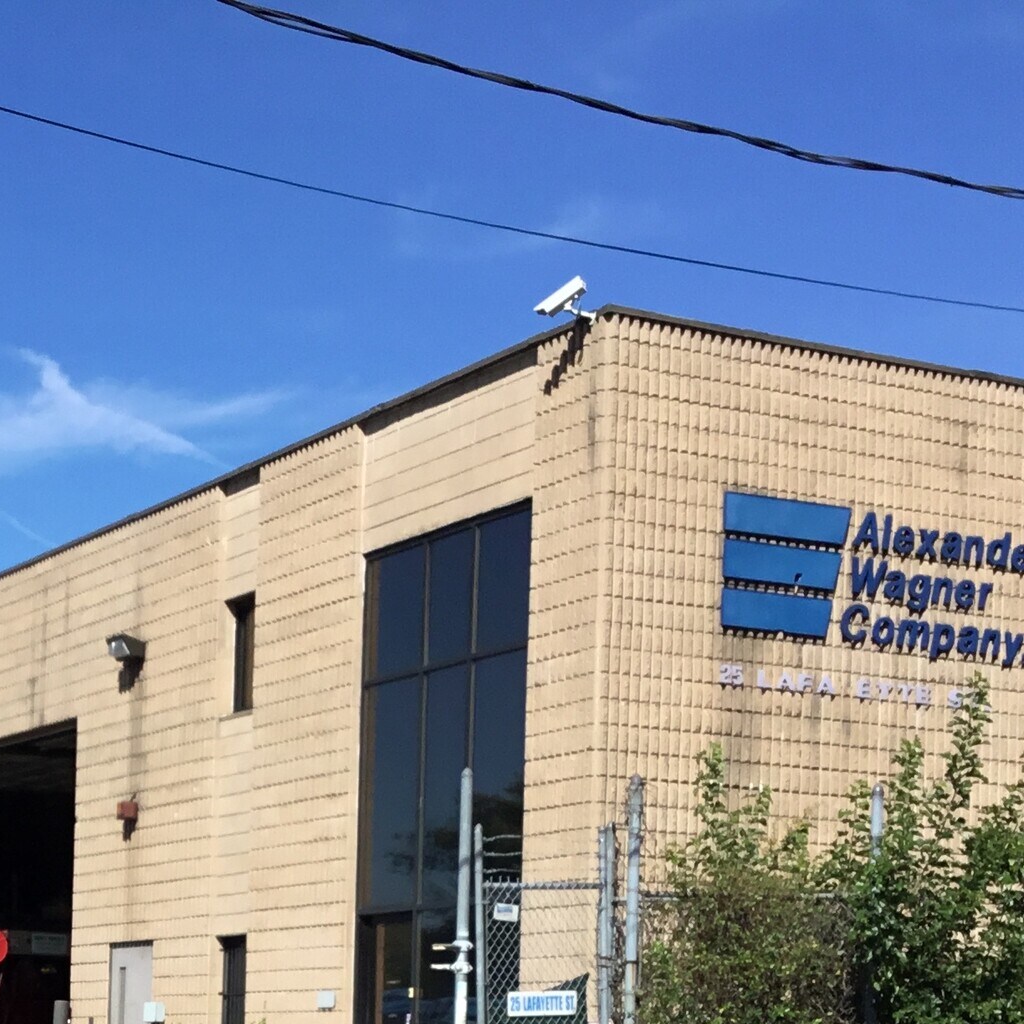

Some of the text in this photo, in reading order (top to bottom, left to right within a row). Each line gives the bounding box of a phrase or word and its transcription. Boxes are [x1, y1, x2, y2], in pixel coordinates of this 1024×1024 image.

[851, 556, 994, 615] Wagner
[719, 663, 744, 685] 25
[510, 996, 521, 1012] 25
[523, 995, 563, 1011] LAFAYETTE
